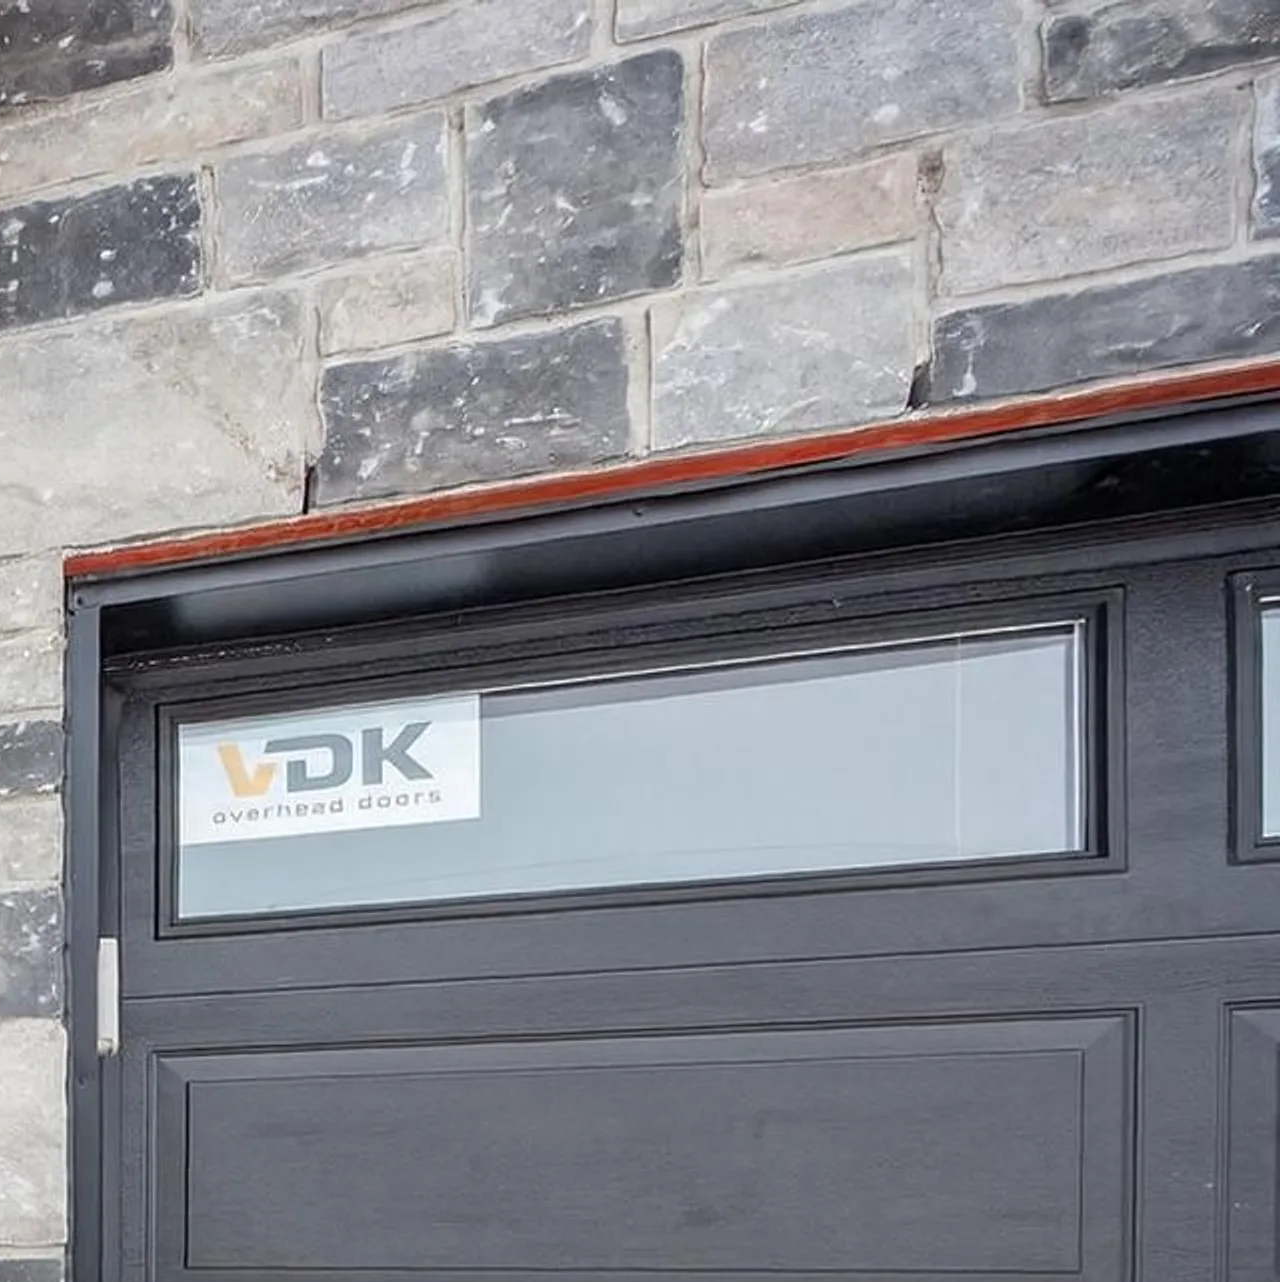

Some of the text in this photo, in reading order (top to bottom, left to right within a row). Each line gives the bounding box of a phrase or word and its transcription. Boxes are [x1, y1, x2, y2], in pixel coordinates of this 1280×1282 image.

[217, 721, 434, 797] VDK
[212, 788, 443, 825] overhead doors
